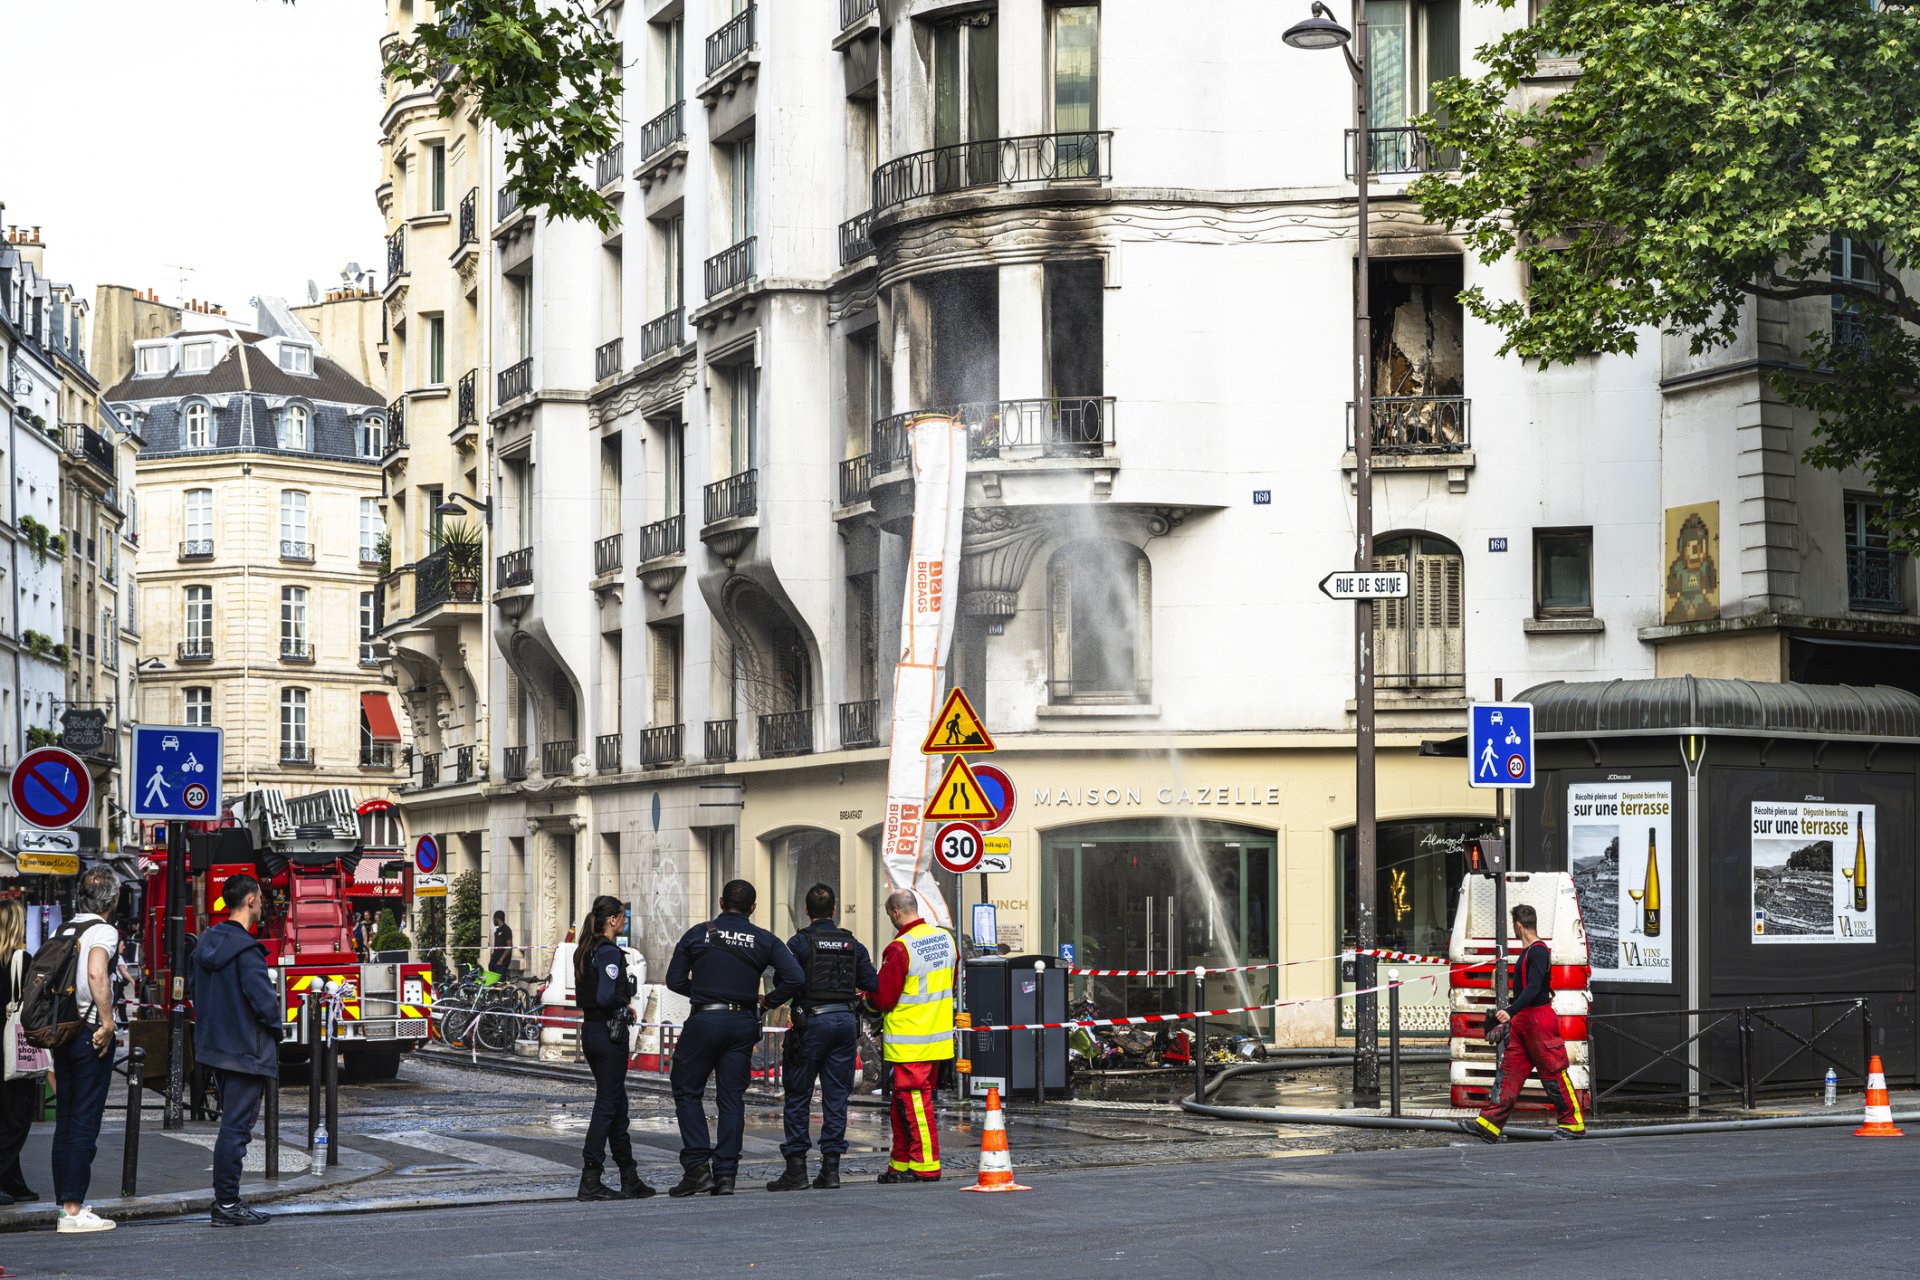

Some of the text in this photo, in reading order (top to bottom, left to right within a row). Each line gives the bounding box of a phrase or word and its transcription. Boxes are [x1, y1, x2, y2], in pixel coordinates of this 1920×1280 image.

[1255, 492, 1270, 502] 160
[1490, 539, 1505, 550] 160
[917, 561, 928, 613] BIGBAGS
[1336, 577, 1401, 593] RUE DE SEINE
[988, 624, 1003, 634] 160
[65, 730, 102, 745] Buci
[1511, 762, 1522, 771] 20
[188, 791, 204, 802] 20
[1033, 786, 1280, 806] MAISON GAZELLE
[1575, 792, 1594, 801] Récolté
[1594, 793, 1607, 801] plein
[1622, 792, 1643, 801] Dégusté
[1656, 791, 1668, 799] frais
[1574, 801, 1669, 816] sur une terrasse
[1754, 806, 1798, 817] Récolté plein sud
[1803, 808, 1848, 818] Dégusté bien frais
[840, 810, 863, 819] BREAKFAST
[886, 804, 899, 854] BIGBAGS
[1753, 818, 1848, 835] sur une terrasse
[1420, 833, 1465, 847] Almond
[945, 836, 974, 858] 30
[1445, 843, 1464, 853] Ba
[1837, 916, 1854, 937] VA
[1854, 921, 1868, 929] VINS
[705, 930, 755, 943] OLICE
[1854, 929, 1874, 938] ALSACE
[704, 938, 755, 949] NONALE
[911, 934, 947, 949] COMMANDANT
[917, 941, 950, 956] OPERATIONS
[1643, 948, 1661, 957] VINS
[923, 950, 949, 962] SECOURS
[1621, 942, 1643, 967] VA
[1643, 958, 1670, 967] ALSACE
[18, 1053, 35, 1061] bag.
